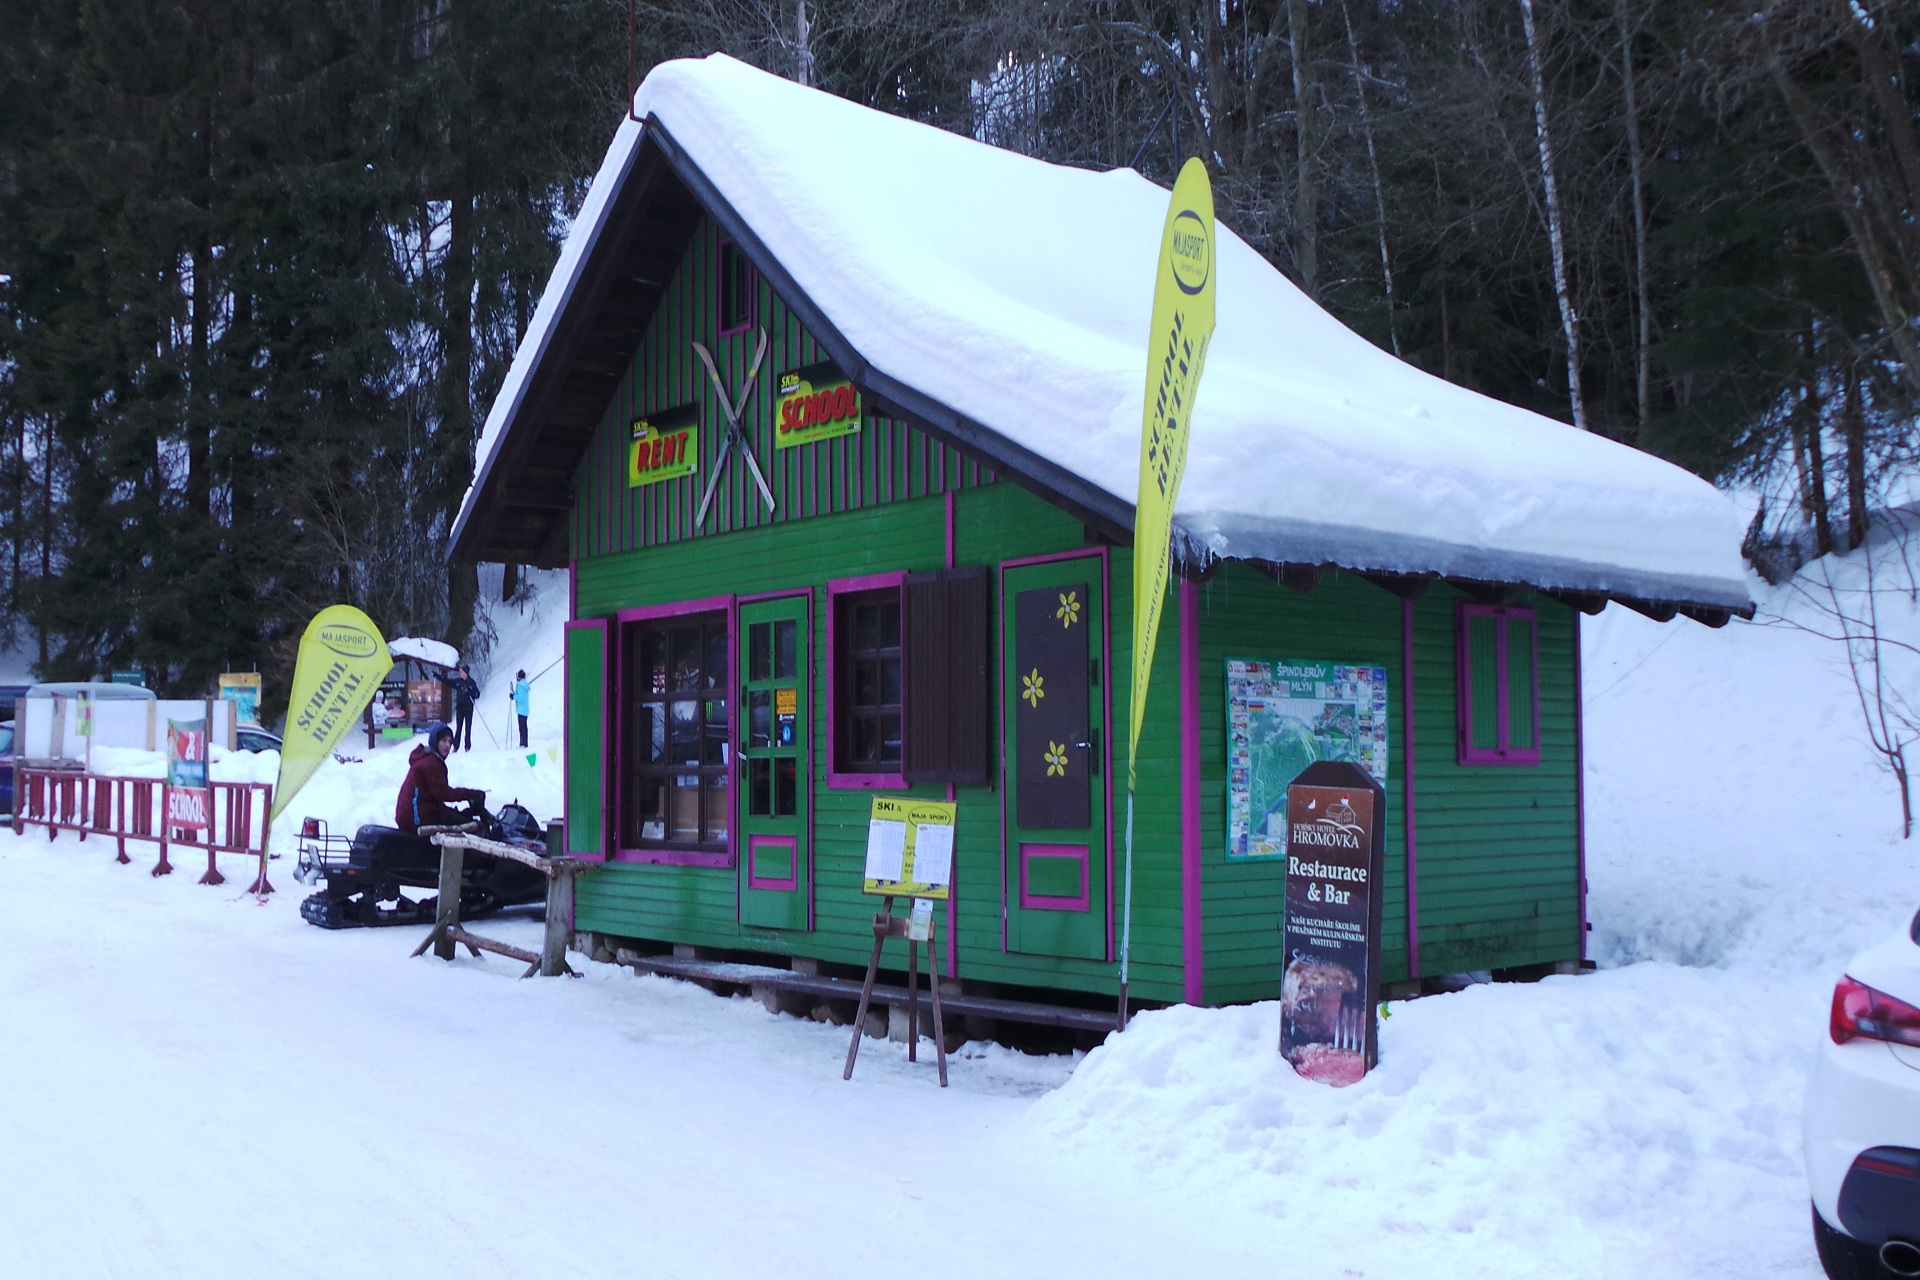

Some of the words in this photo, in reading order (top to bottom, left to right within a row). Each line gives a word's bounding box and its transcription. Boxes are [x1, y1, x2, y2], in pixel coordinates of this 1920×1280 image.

[1172, 232, 1204, 267] MAJASPORT
[1148, 307, 1185, 472] SCHOOL
[779, 383, 857, 432] SCHOOL
[1157, 337, 1194, 501] RENTAL
[637, 431, 688, 472] RENT
[1277, 661, 1326, 678] ŠPINDLERŮV
[1291, 677, 1312, 692] MLÝN
[297, 660, 348, 731] SCHOOL
[311, 673, 364, 744] RENTAL
[168, 791, 206, 823] SCHOOL
[877, 801, 895, 812] SKI
[1293, 830, 1360, 849] HROMOVKA
[1288, 856, 1368, 883] Restaurace
[1307, 882, 1321, 902] &
[1324, 884, 1351, 905] Bar
[1310, 937, 1342, 949] INSTITUTU
